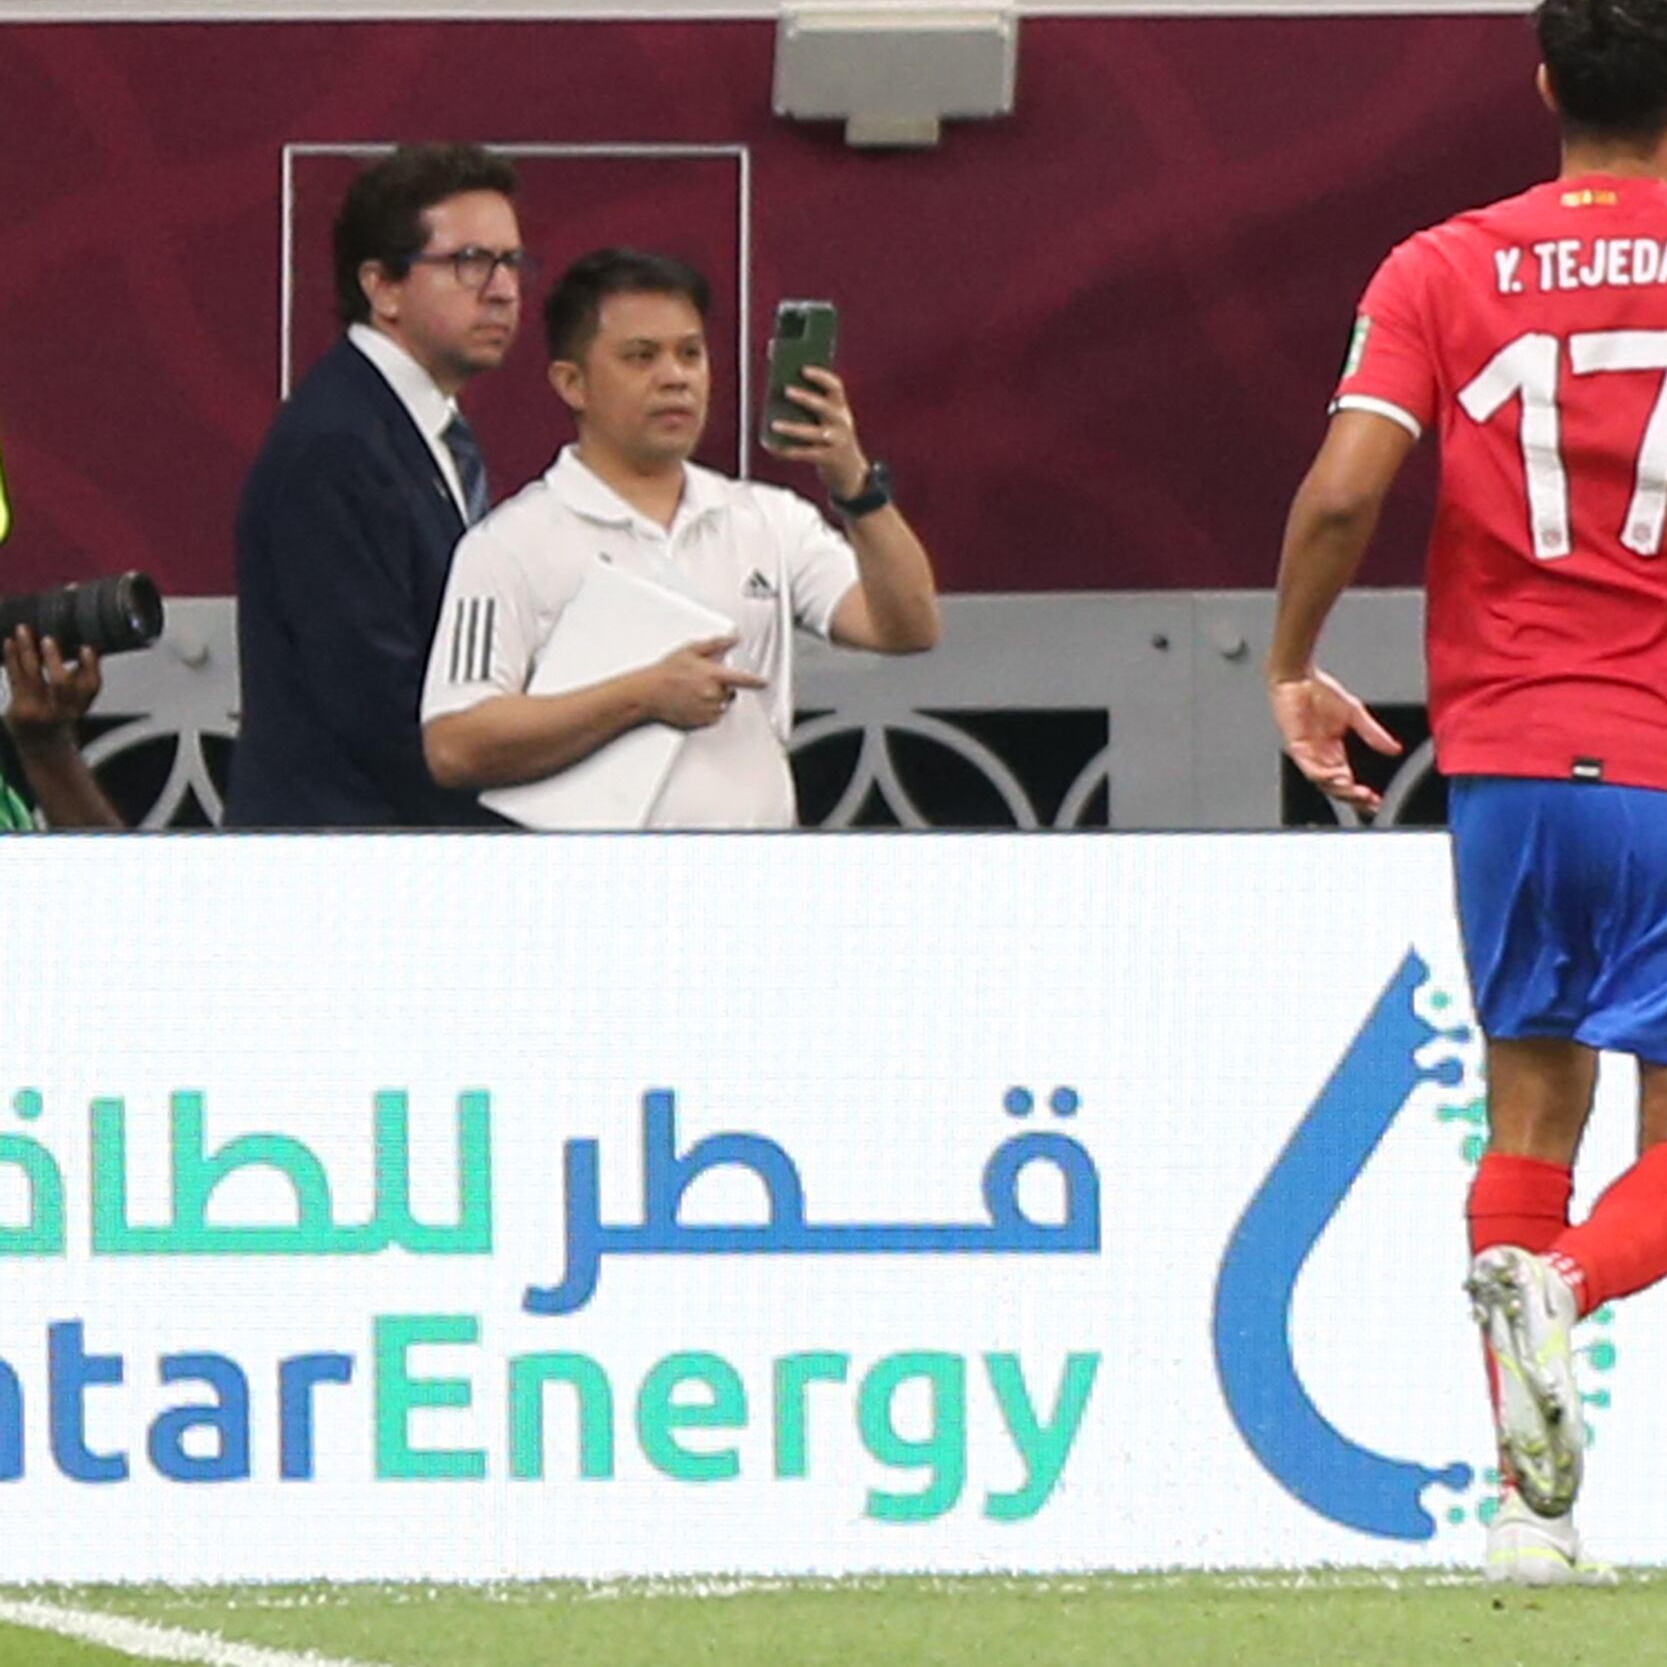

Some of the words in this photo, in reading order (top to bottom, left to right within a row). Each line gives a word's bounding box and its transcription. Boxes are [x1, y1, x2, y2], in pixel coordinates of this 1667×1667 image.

[1494, 246, 1524, 294] Y.
[523, 1085, 1103, 1317] قطر
[0, 1313, 1103, 1525] tarEnergy
